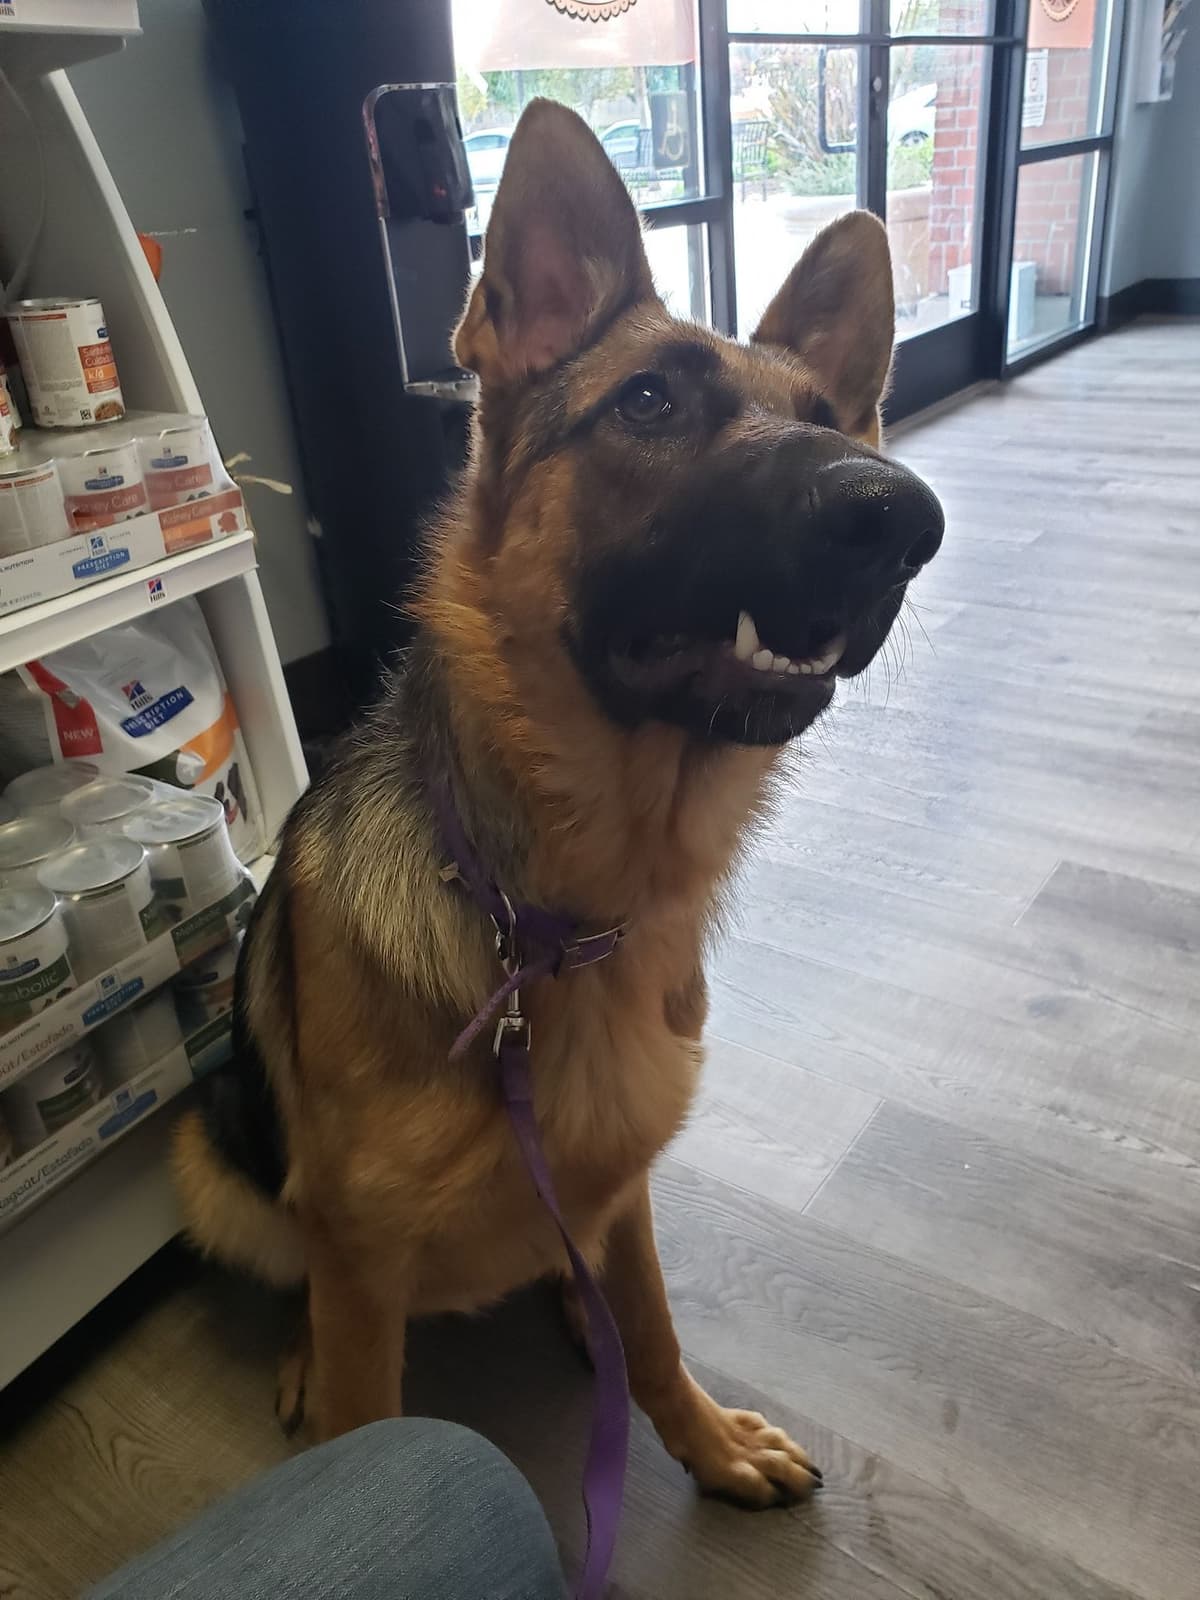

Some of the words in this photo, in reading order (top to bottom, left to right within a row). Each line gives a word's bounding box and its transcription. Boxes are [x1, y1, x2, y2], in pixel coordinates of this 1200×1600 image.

[111, 494, 138, 508] Care
[144, 713, 165, 730] DIET
[63, 728, 95, 741] NEW
